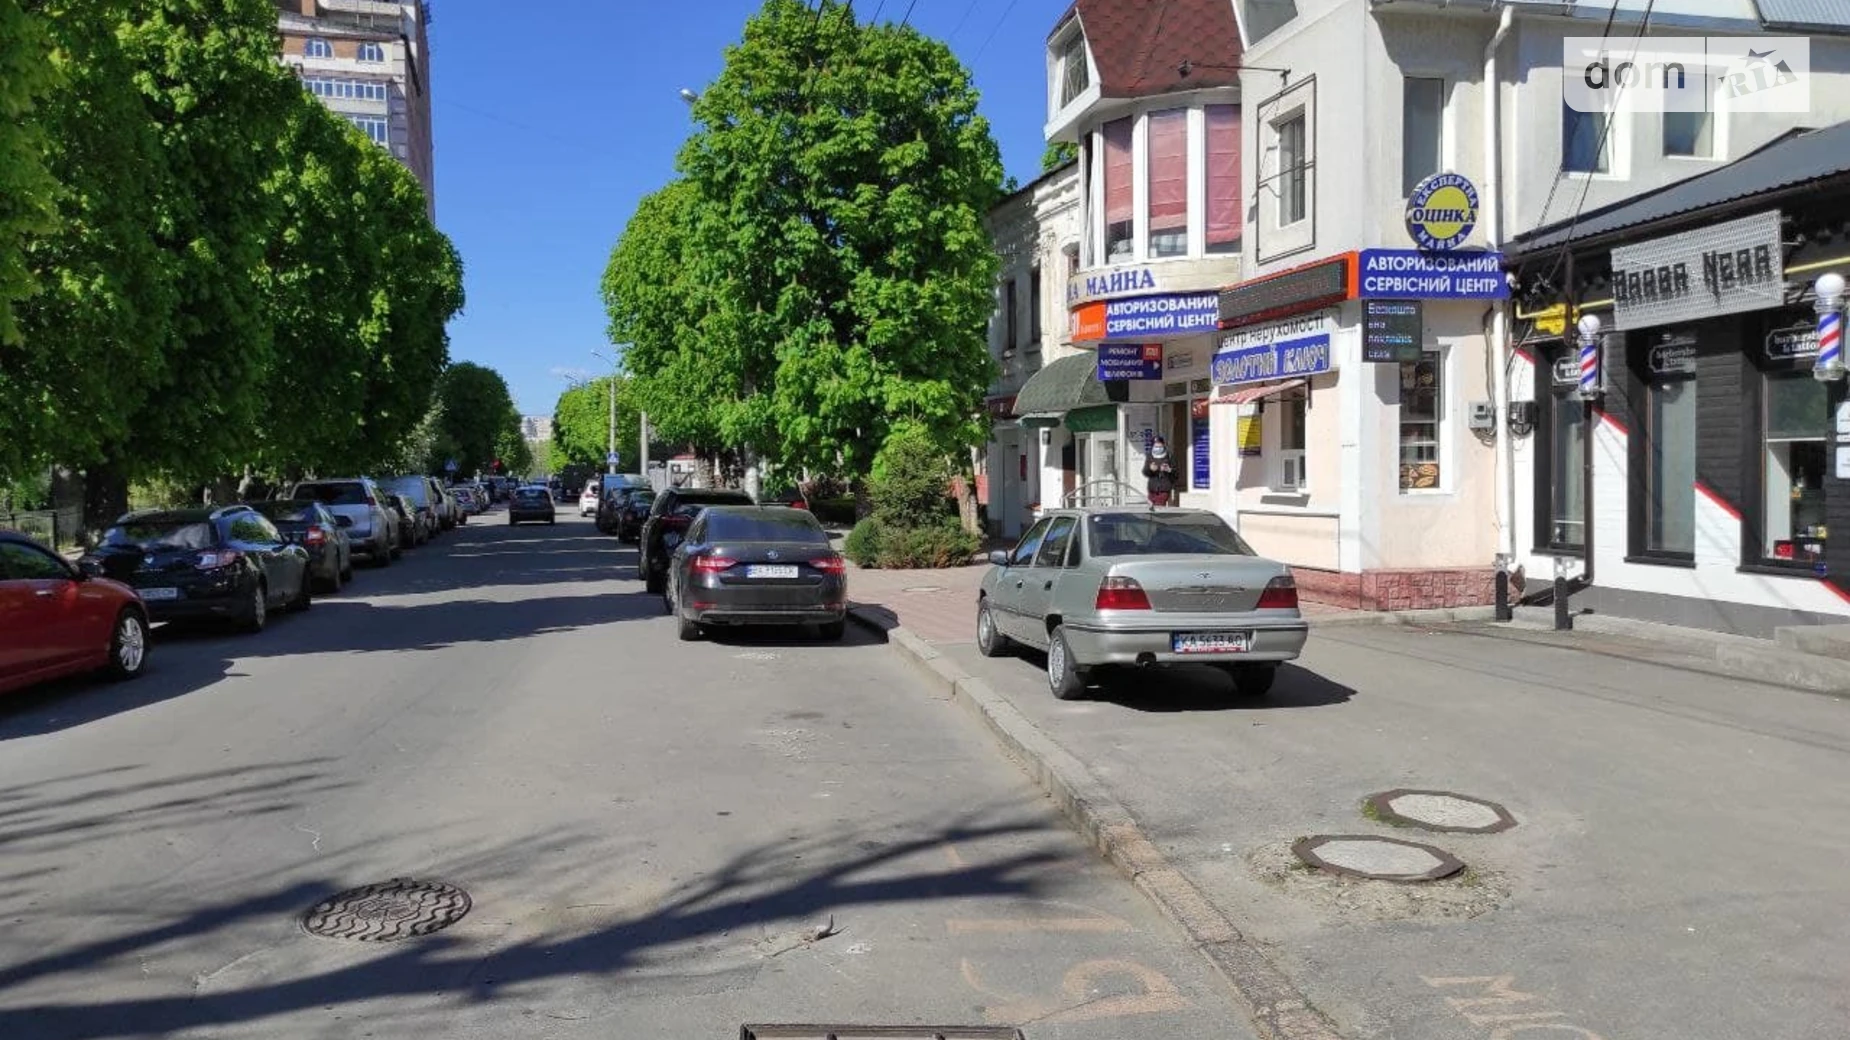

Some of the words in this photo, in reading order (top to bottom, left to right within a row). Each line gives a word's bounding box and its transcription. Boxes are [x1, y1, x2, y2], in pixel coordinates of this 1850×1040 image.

[1412, 209, 1476, 223] ОЦІНКА
[1366, 255, 1499, 272] АВТОРИЗОВАНИЙ
[1086, 266, 1156, 296] МАЙНА
[1364, 276, 1451, 292] СЕРВІСНИЙ
[1455, 279, 1498, 295] ЦЕНТР
[1106, 296, 1218, 317] АВТОРИЗОВАНИЙ
[1106, 315, 1174, 333] СЕРВІСНИЙ
[1177, 312, 1219, 328] ЦЕНТР
[1249, 311, 1324, 342] нерухомості
